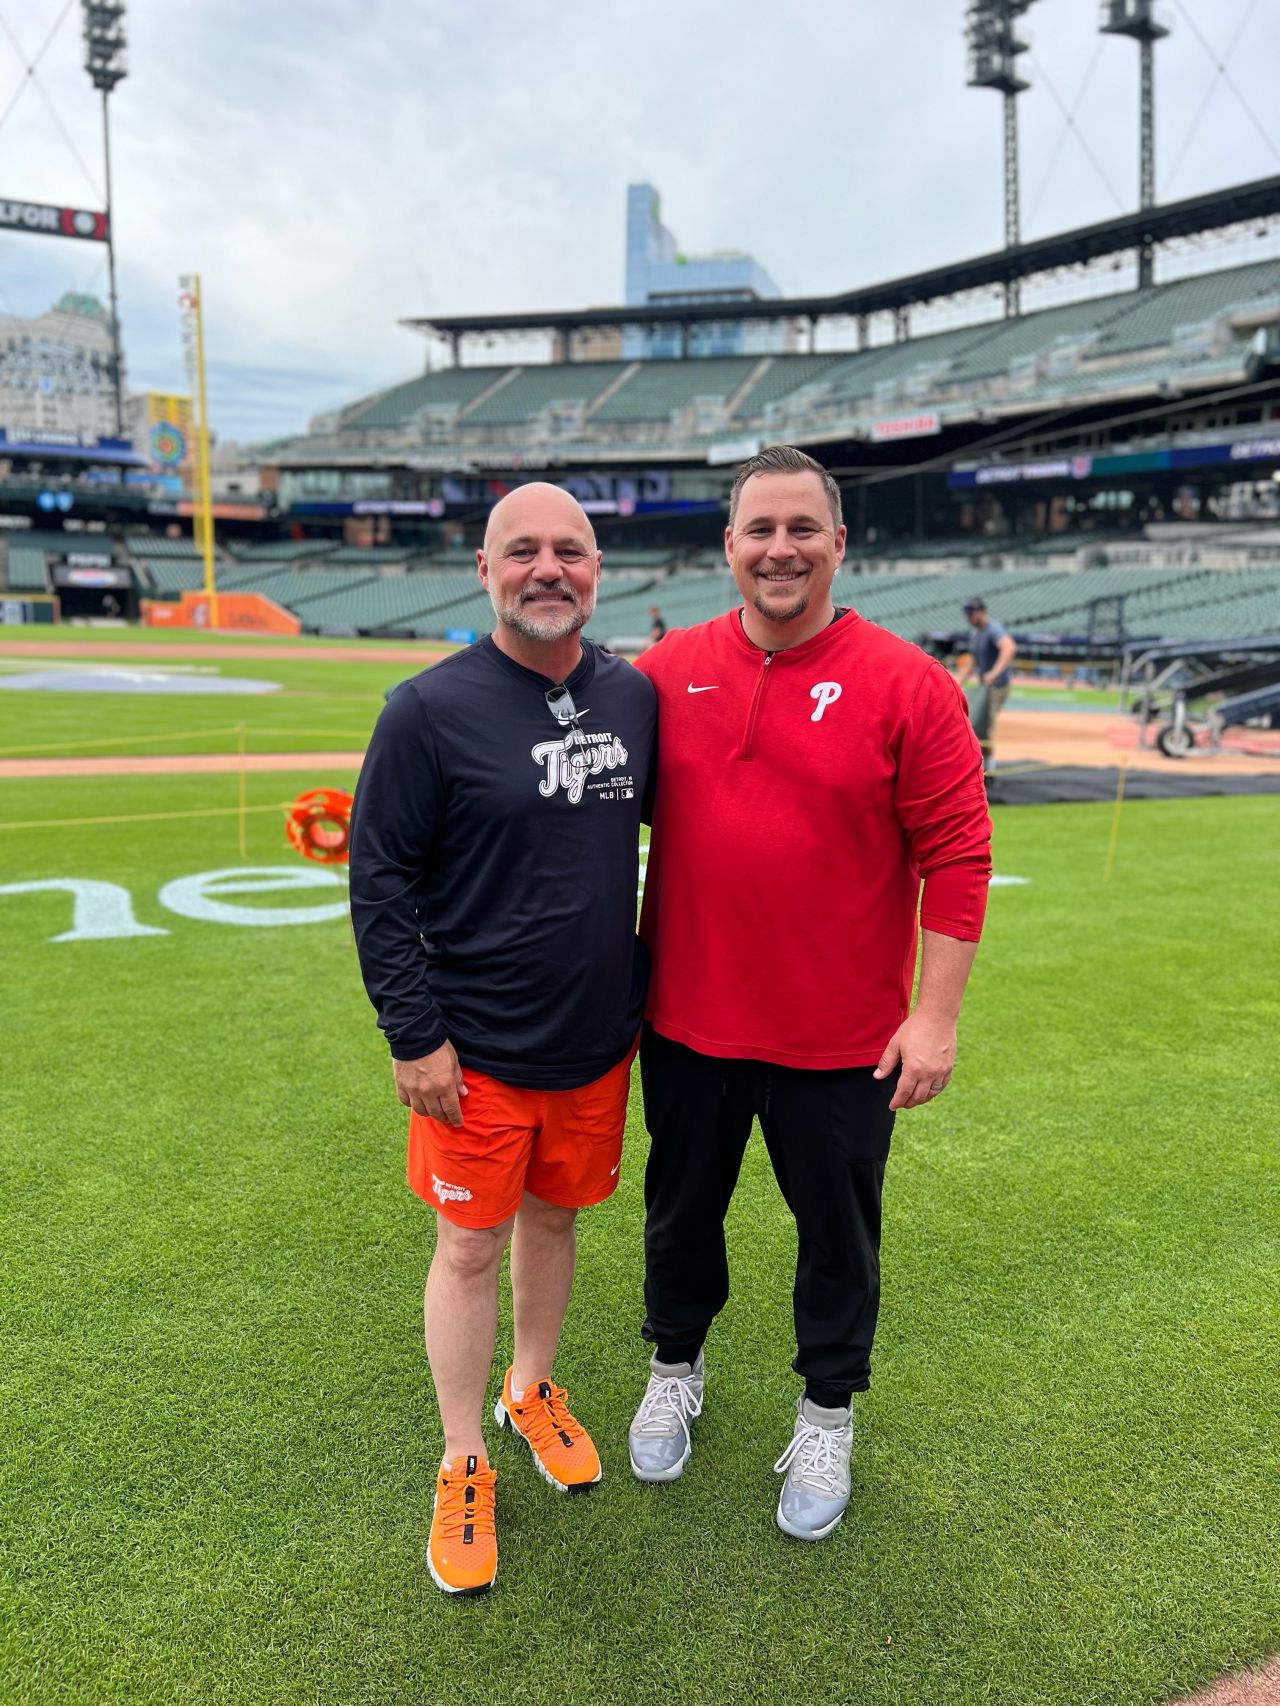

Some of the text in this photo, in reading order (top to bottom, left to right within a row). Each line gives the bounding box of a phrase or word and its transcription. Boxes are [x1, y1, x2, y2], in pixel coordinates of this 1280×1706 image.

[810, 681, 842, 722] P
[574, 732, 613, 745] DETROIT
[531, 736, 628, 804] Tigers
[587, 782, 610, 790] AUTHENTIC
[600, 791, 614, 800] MLB
[432, 1173, 474, 1205] Tigers
